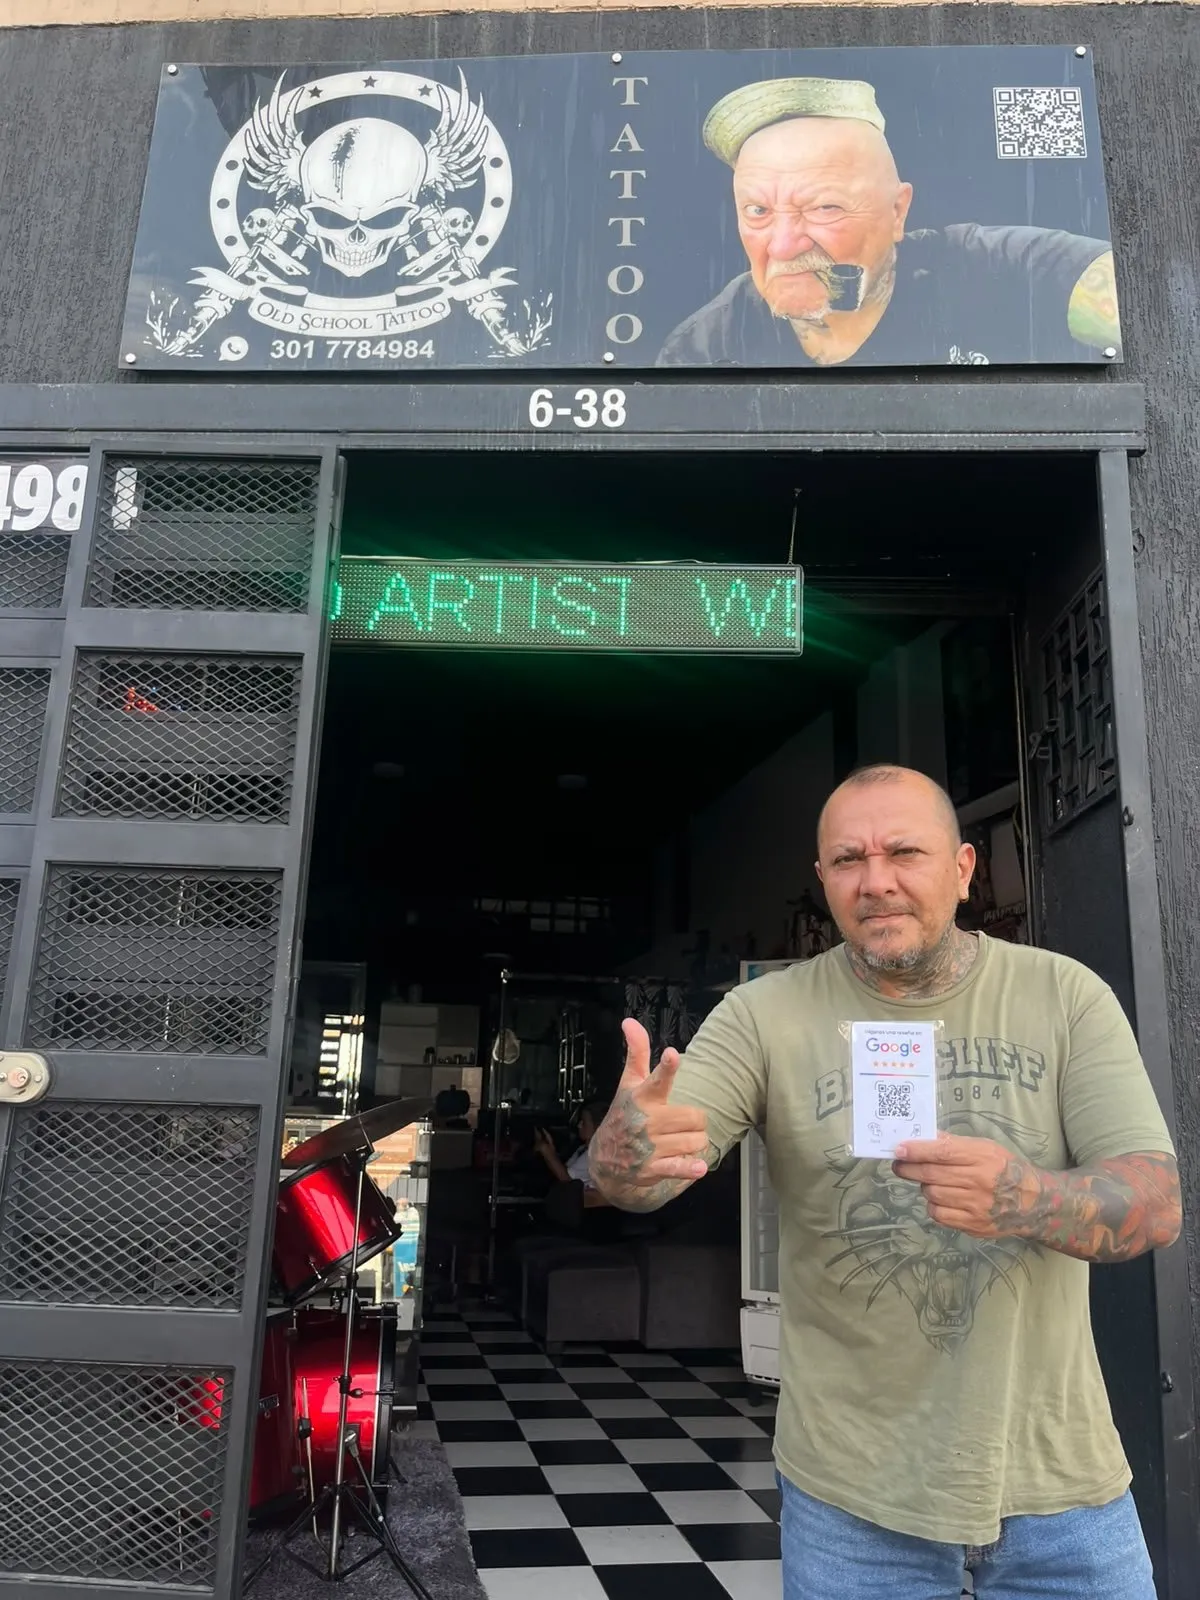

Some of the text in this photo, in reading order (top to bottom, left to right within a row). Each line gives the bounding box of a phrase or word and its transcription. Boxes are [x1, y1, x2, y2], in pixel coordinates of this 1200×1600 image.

[604, 76, 649, 344] TATTOO
[270, 339, 435, 359] 301 7784984
[528, 388, 627, 428] 6-38
[367, 572, 632, 637] ARTIST
[866, 1037, 921, 1057] Google
